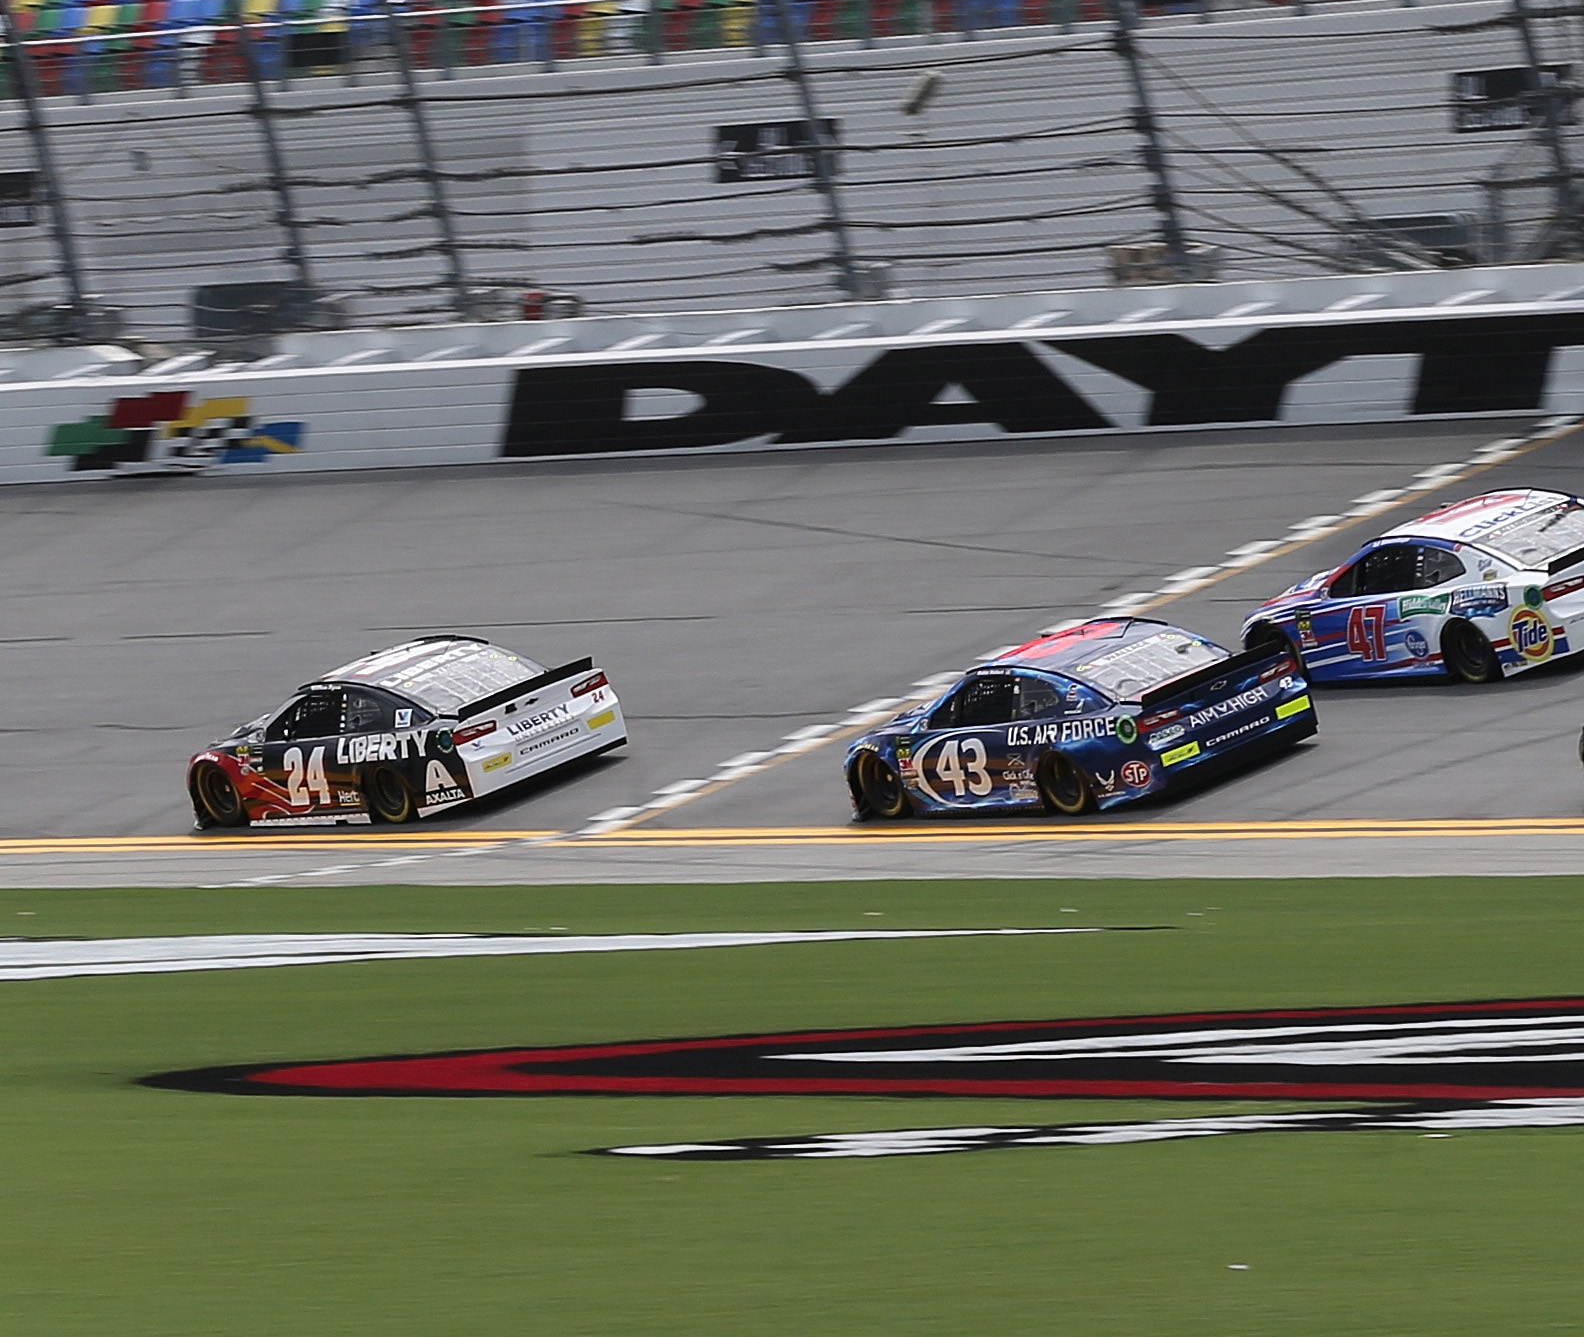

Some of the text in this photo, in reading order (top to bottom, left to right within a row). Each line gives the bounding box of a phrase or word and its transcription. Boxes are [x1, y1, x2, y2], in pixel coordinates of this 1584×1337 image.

[1347, 604, 1388, 662] 47
[1512, 620, 1548, 653] Tide
[380, 643, 481, 687] LIBERTY
[592, 690, 605, 704] 24
[1279, 676, 1293, 689] 43
[507, 703, 570, 736] LIBERTY
[1007, 716, 1117, 746] U.S. AIR FORCE
[1205, 716, 1270, 747] CAMARO
[337, 728, 430, 764] LIBERTY
[520, 727, 579, 755] CAMARO
[283, 746, 332, 806] 24
[936, 738, 993, 797] 43
[1124, 764, 1148, 783] STP
[425, 788, 466, 805] AXALTA
